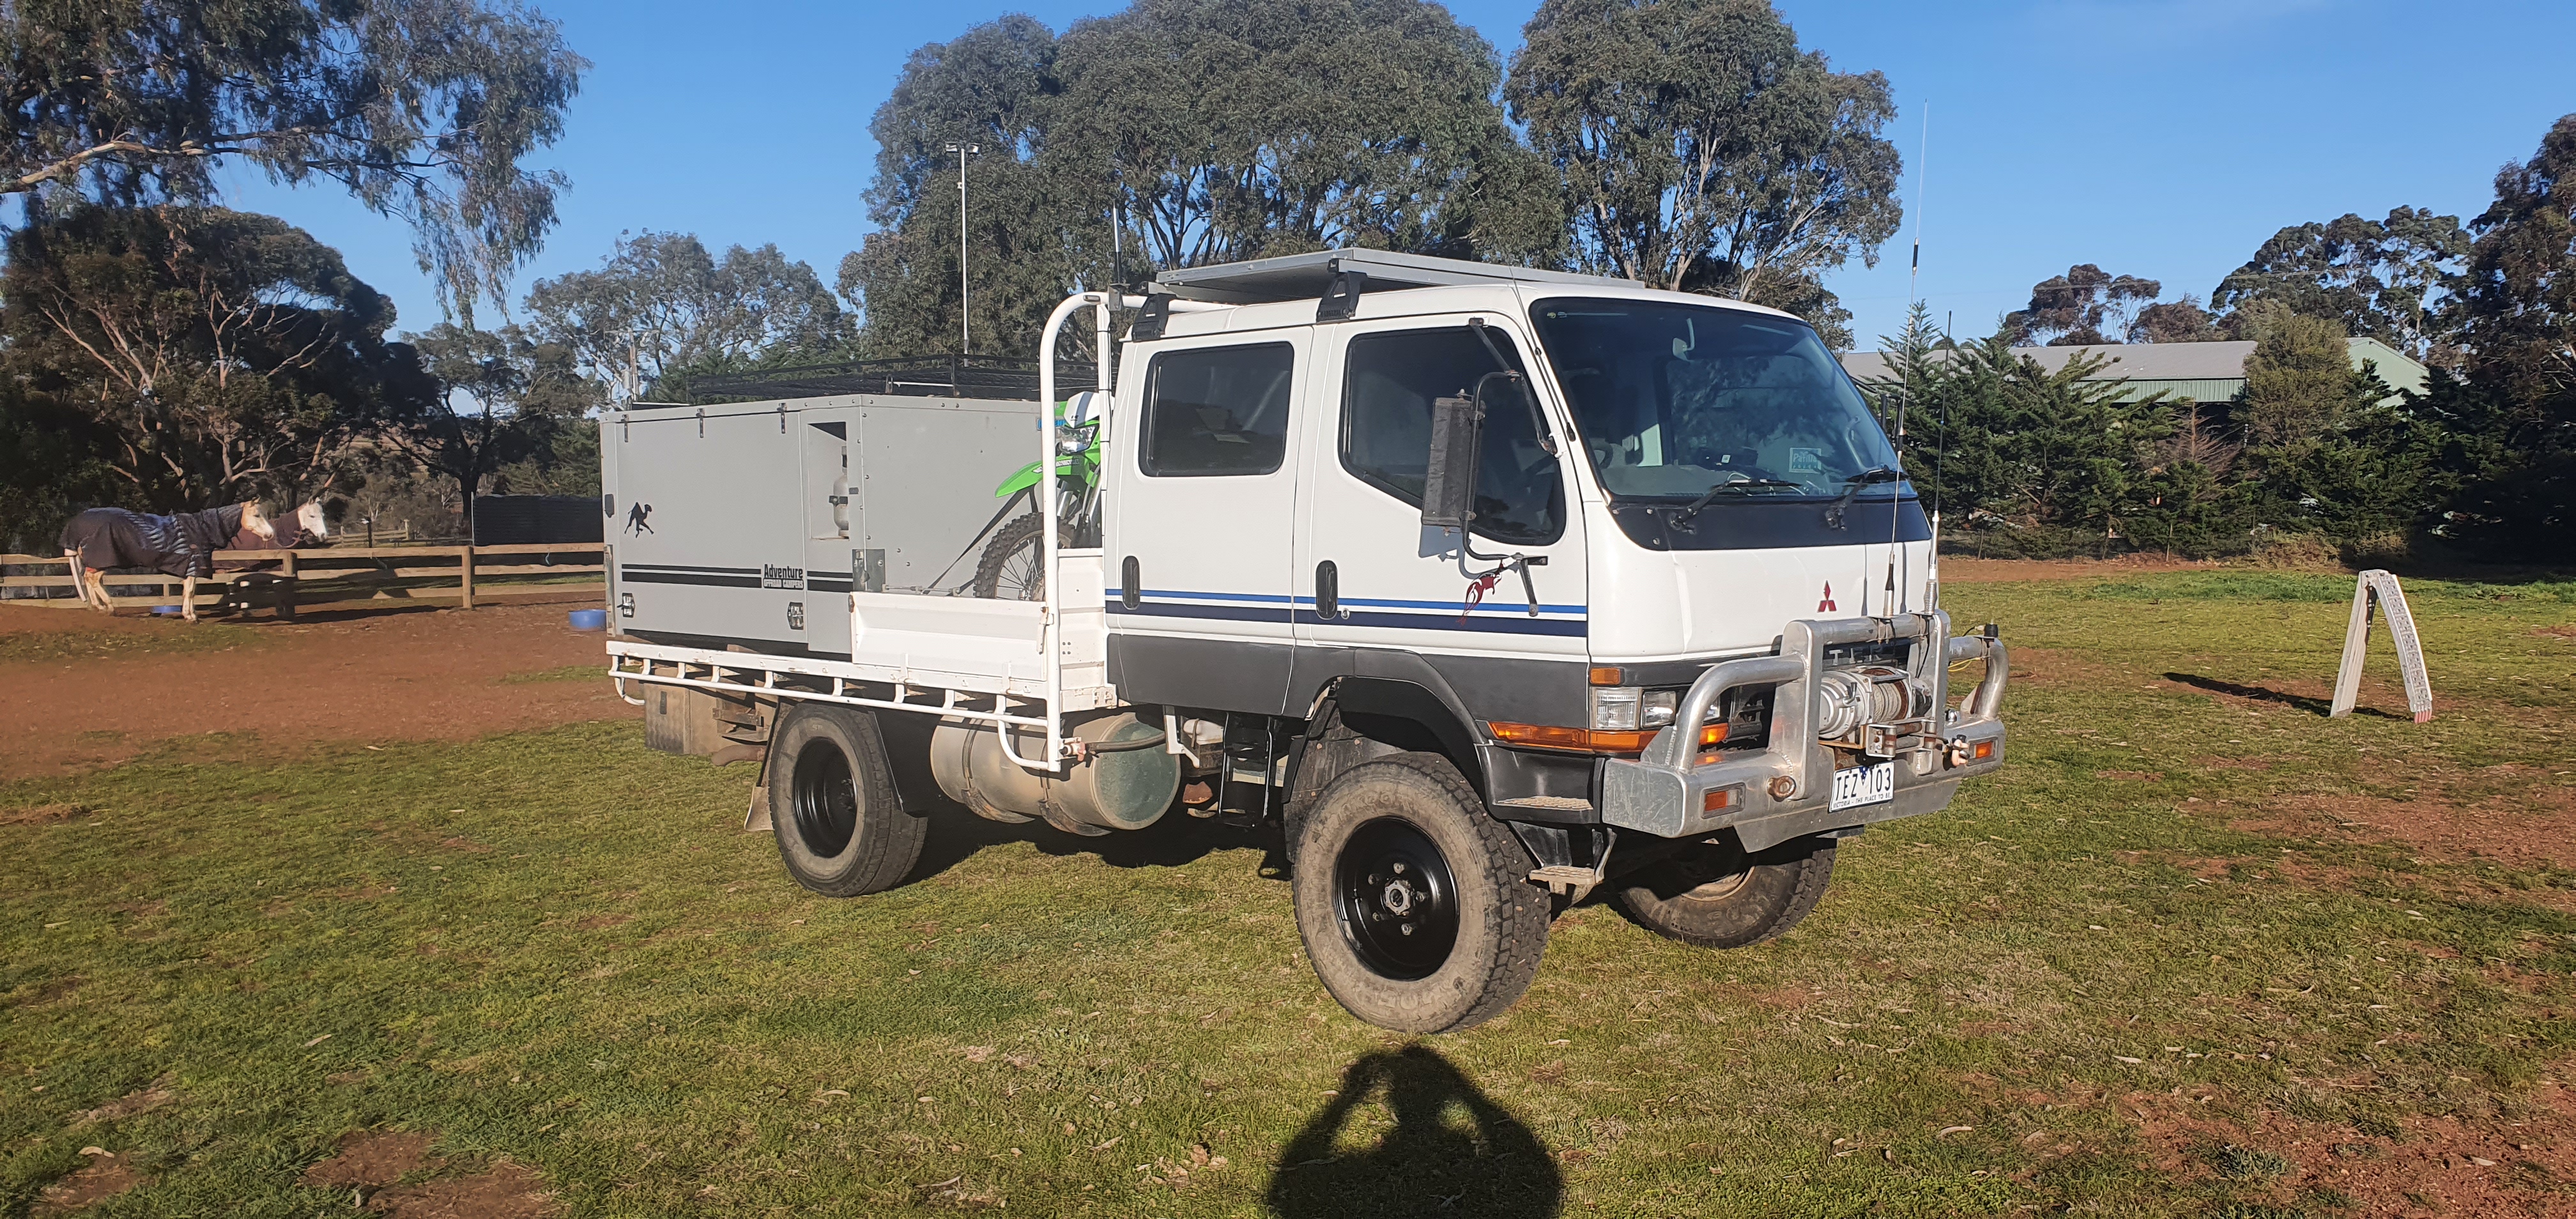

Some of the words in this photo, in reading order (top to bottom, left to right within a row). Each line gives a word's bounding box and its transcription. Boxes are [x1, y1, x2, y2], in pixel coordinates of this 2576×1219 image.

[764, 564, 803, 578] Adventure
[1828, 643, 1883, 666] TER
[1836, 773, 1858, 801] TEZ
[1869, 767, 1891, 794] 103
[1833, 800, 1850, 809] VICTORIA
[1864, 794, 1876, 802] PLACE
